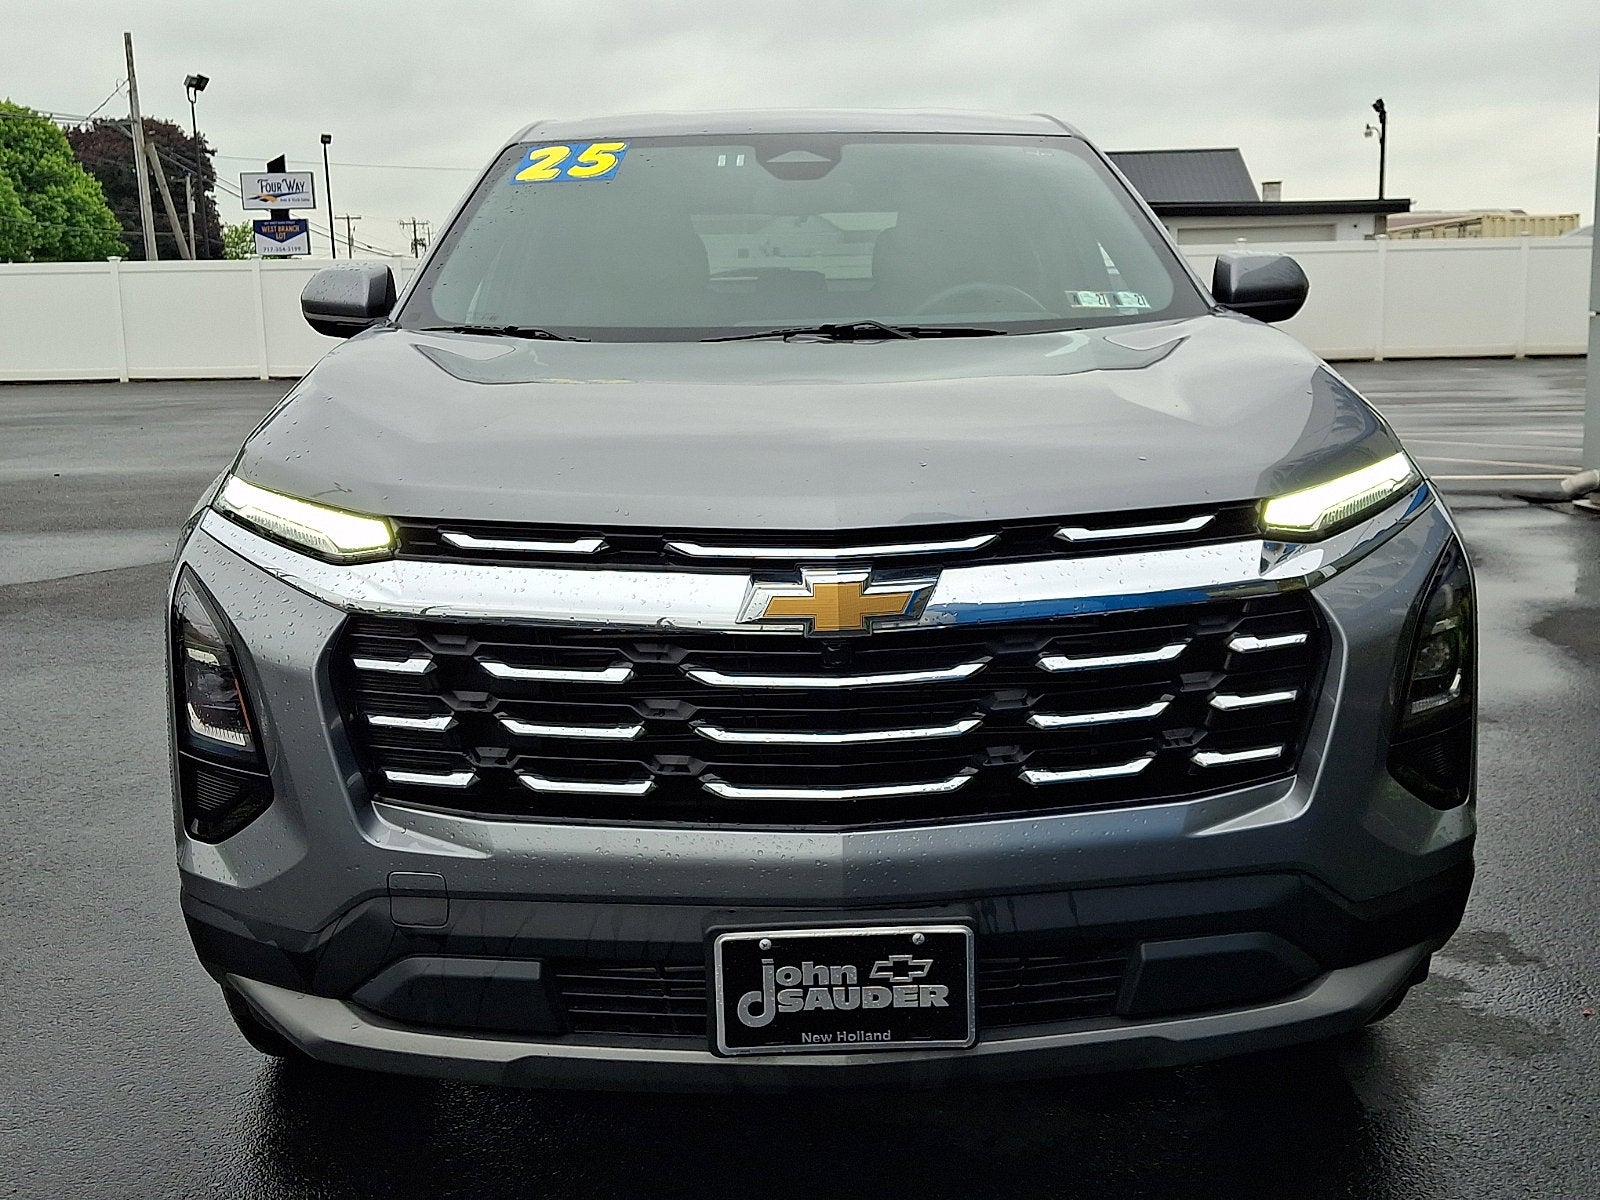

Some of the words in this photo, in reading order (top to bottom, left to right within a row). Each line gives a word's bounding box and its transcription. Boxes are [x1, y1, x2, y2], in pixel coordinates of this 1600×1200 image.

[515, 142, 627, 181] 25
[257, 178, 282, 193] FOUR
[282, 178, 305, 193] WAY
[275, 232, 286, 240] LOT
[737, 958, 858, 1028] john
[777, 984, 950, 1013] SAUDER
[801, 1032, 833, 1043] New
[837, 1030, 892, 1043] Holland
